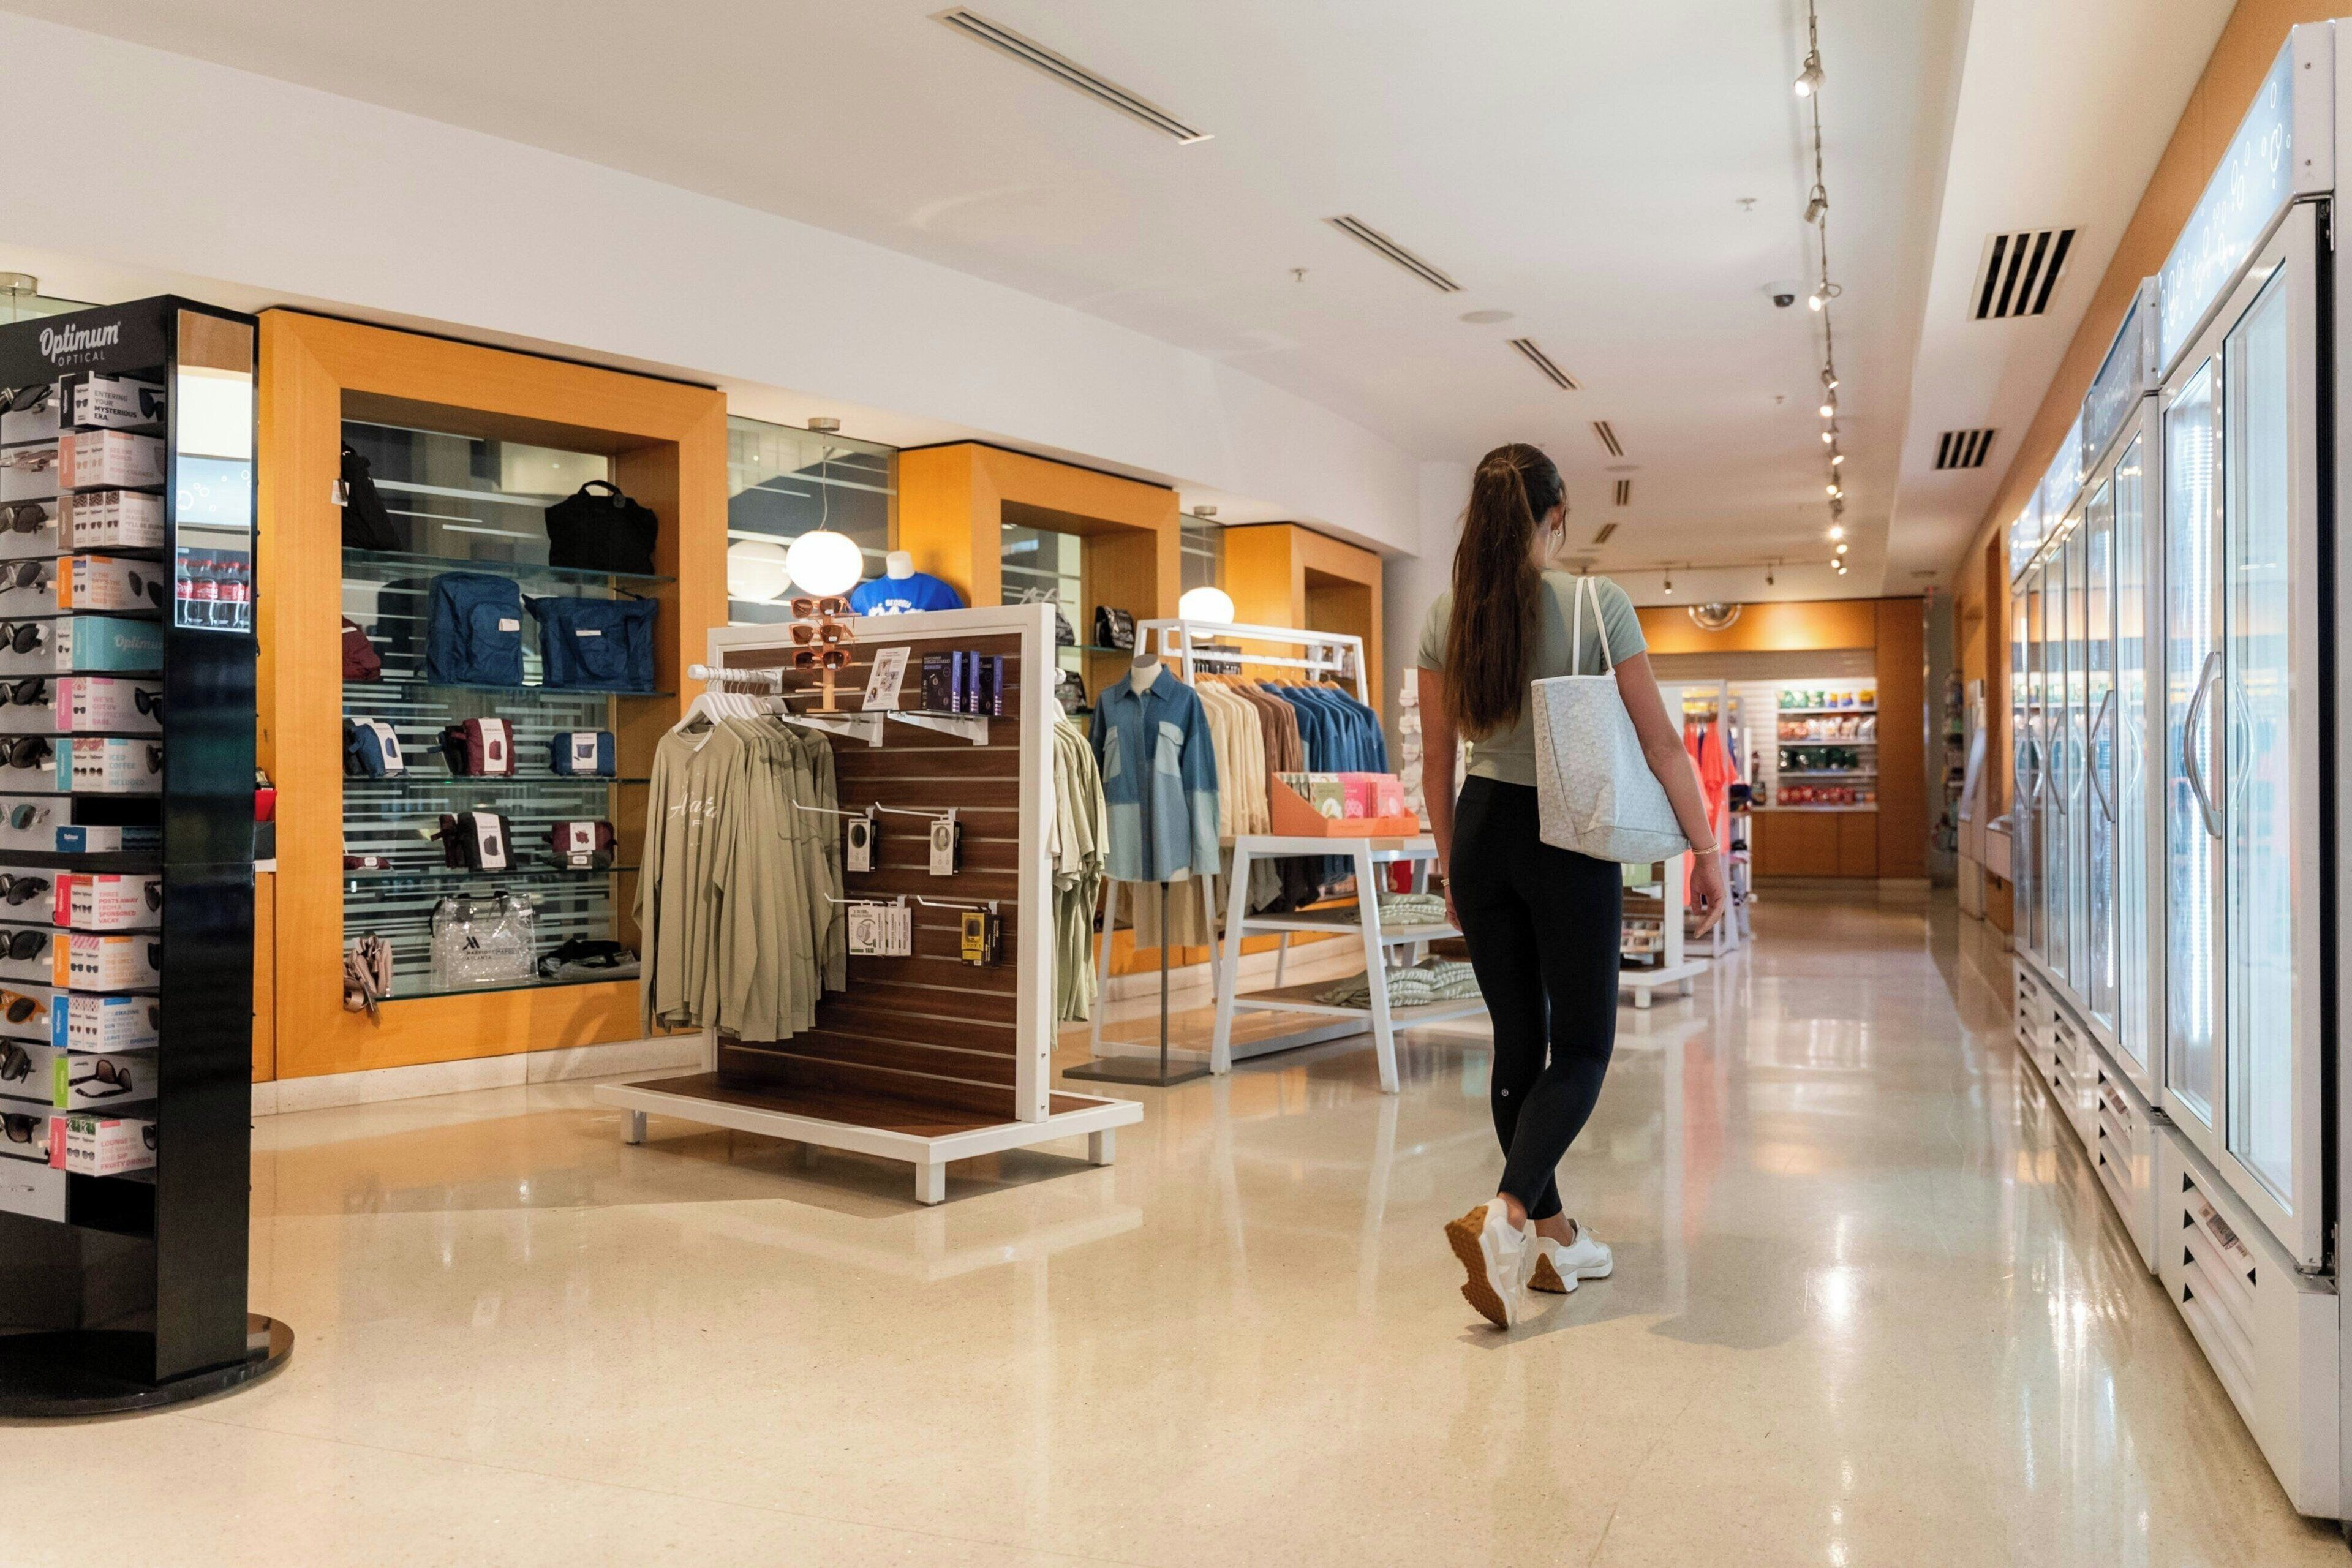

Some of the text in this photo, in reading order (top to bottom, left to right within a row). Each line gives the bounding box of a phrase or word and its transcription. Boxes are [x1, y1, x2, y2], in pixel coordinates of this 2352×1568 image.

[39, 323, 119, 363] Optimum
[58, 350, 105, 366] OPTICAL
[94, 390, 128, 402] ENTERING
[94, 398, 113, 407] YOUR
[94, 405, 138, 419] MYSTERIOUS
[94, 413, 109, 421] ERA.
[884, 598, 912, 609] GEORGIA
[100, 1138, 128, 1147] LOUNGE
[100, 1160, 126, 1170] FRUITY
